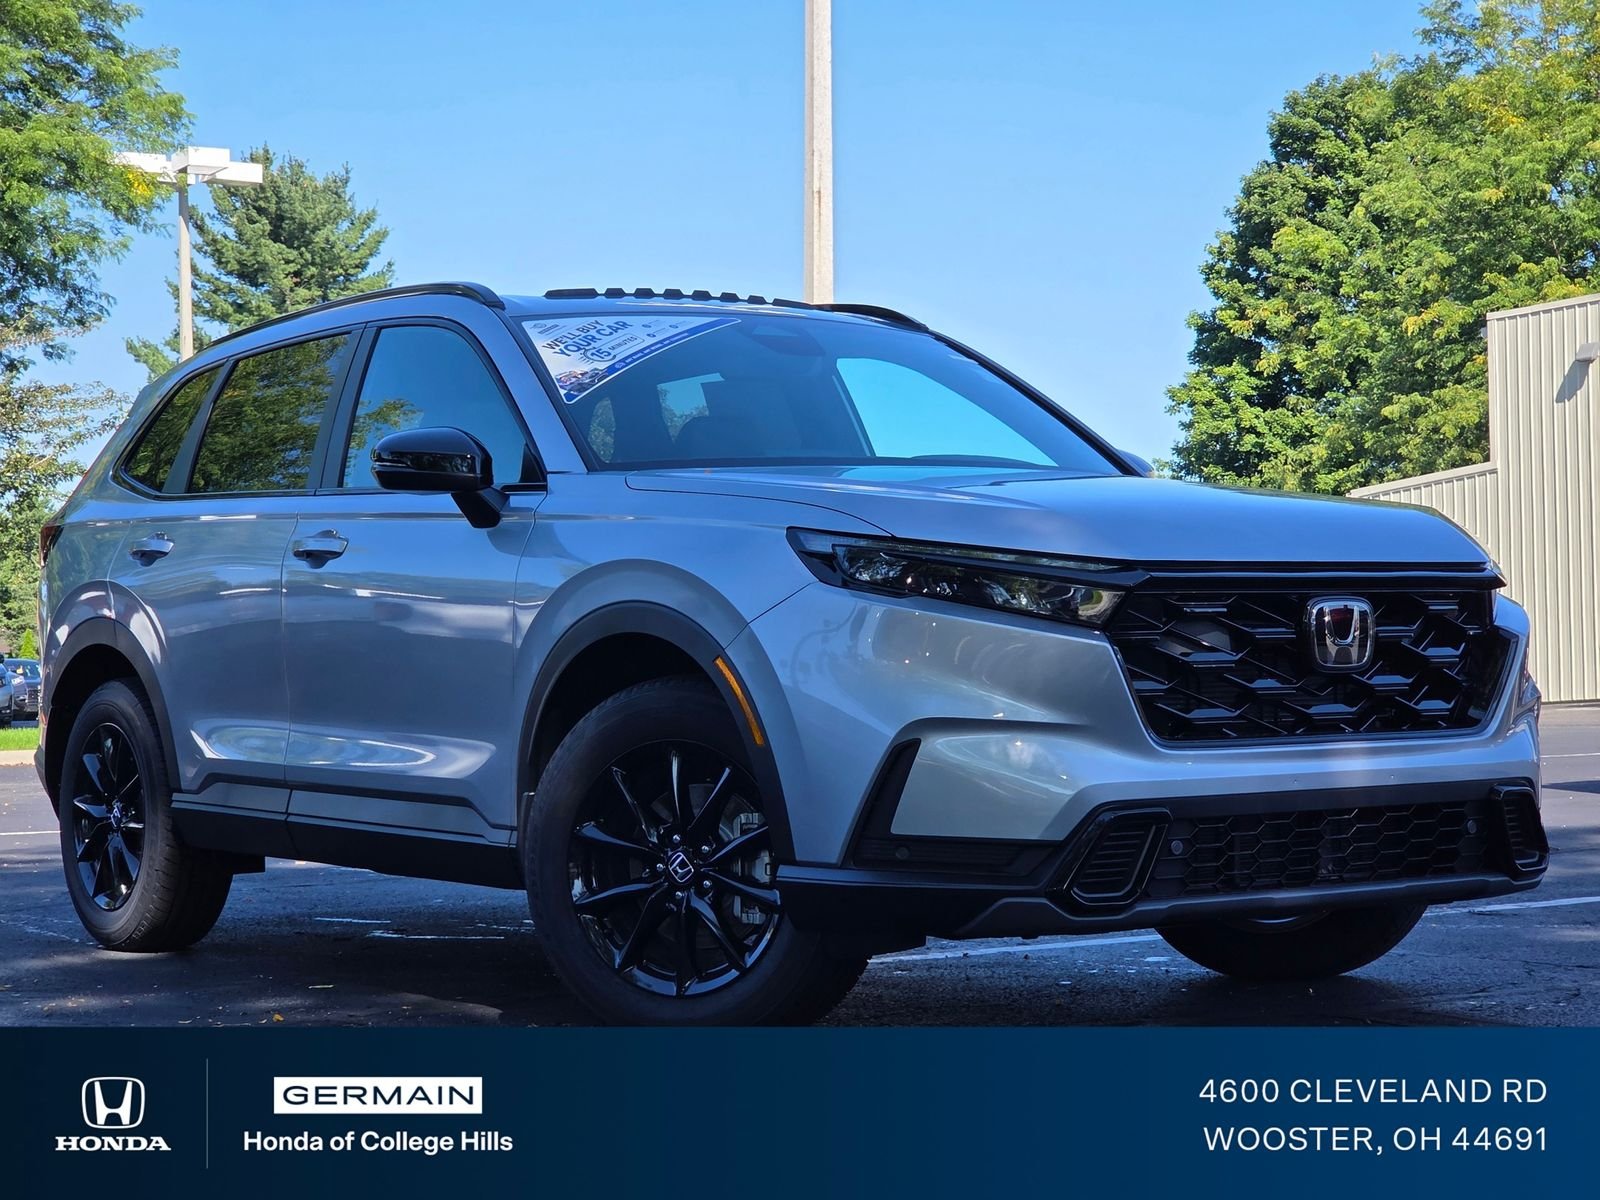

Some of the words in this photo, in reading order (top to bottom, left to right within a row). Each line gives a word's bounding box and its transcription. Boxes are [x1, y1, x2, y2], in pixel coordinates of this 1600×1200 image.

[543, 332, 581, 350] WE'LL
[576, 320, 604, 333] BUY
[552, 334, 602, 357] YOUR
[595, 320, 633, 336] CAR
[590, 348, 612, 360] 15
[608, 336, 638, 350] MINUTES
